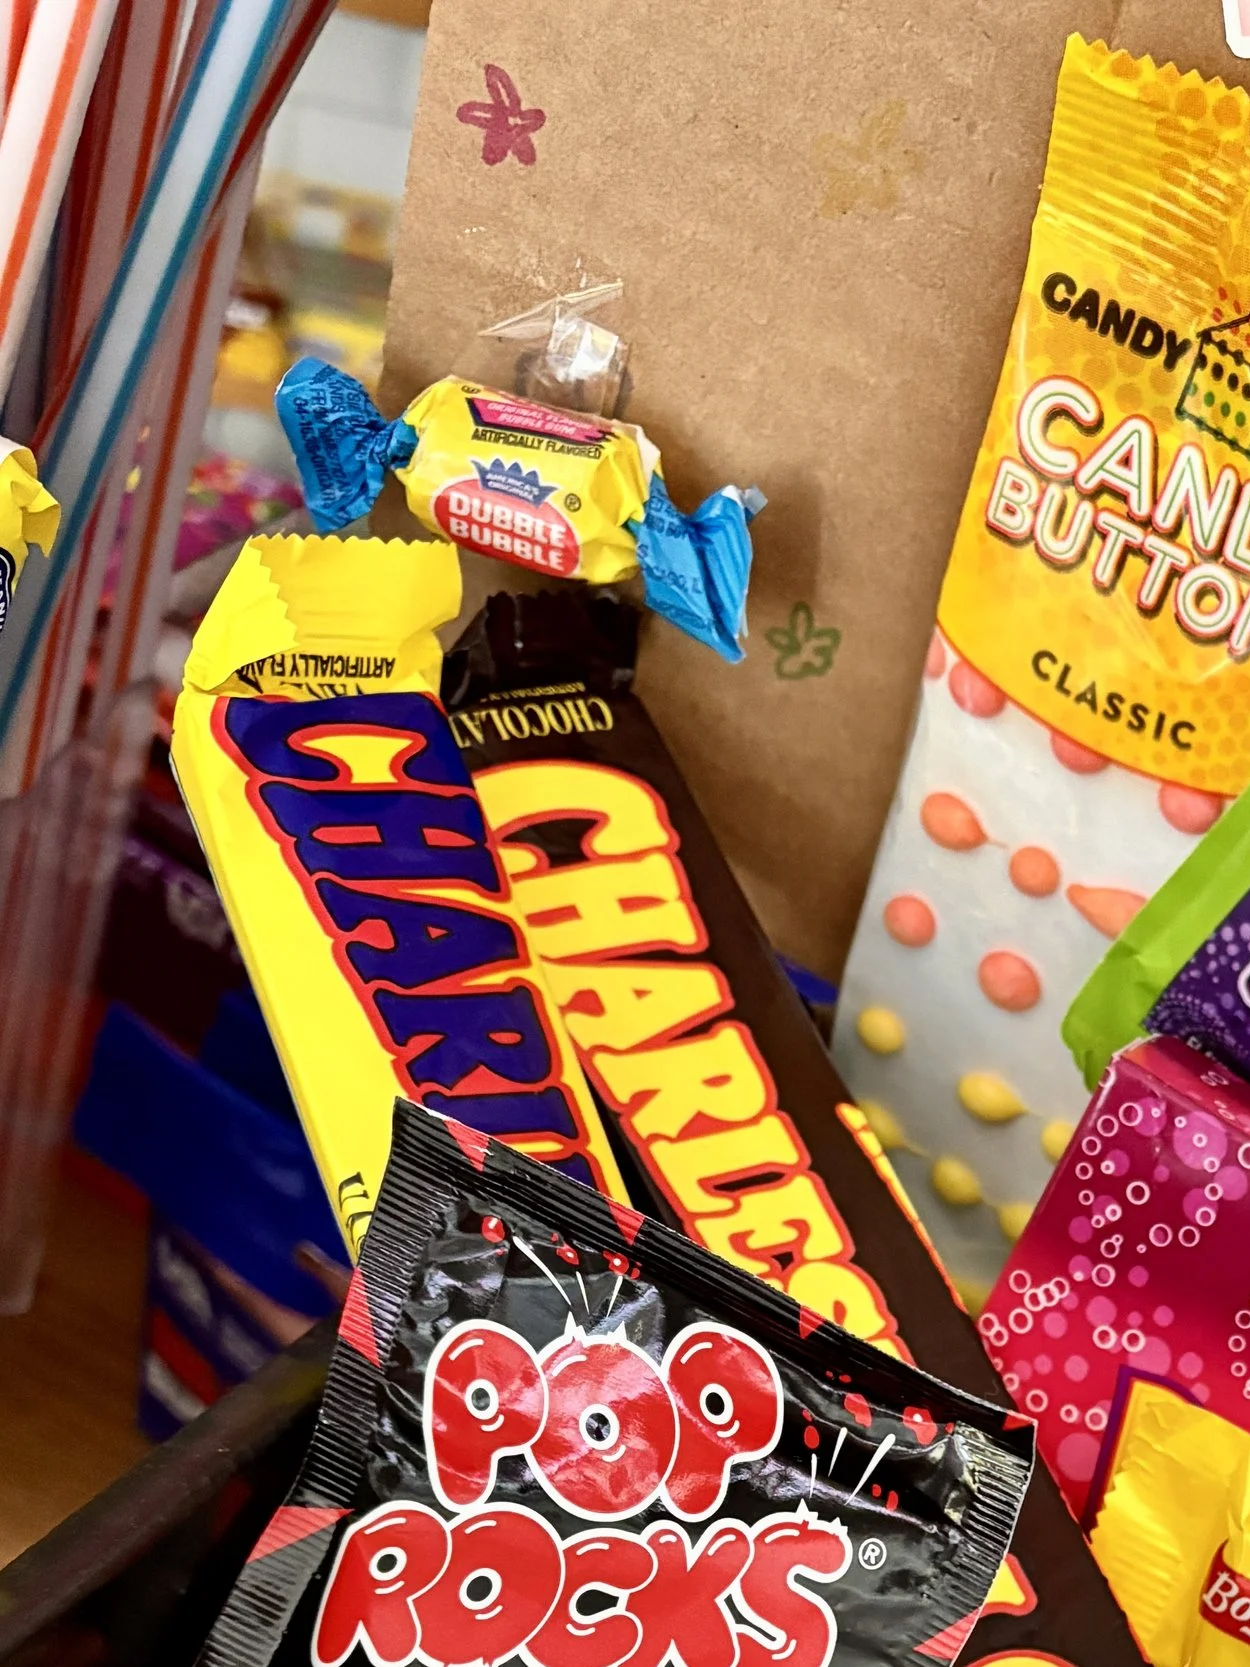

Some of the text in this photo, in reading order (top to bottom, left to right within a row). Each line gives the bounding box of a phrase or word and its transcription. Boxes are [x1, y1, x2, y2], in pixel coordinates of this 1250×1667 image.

[1041, 272, 1192, 373] CANDY
[471, 428, 601, 460] ARTIFICIALLY FLAVORED
[449, 491, 566, 548] DUBBLE
[449, 517, 565, 571] BUBBLE
[287, 653, 395, 679] ARTIFICIALLY
[451, 698, 613, 748] CHOCOLAT
[1031, 649, 1197, 752] CLASSIC
[421, 1316, 784, 1523] POP
